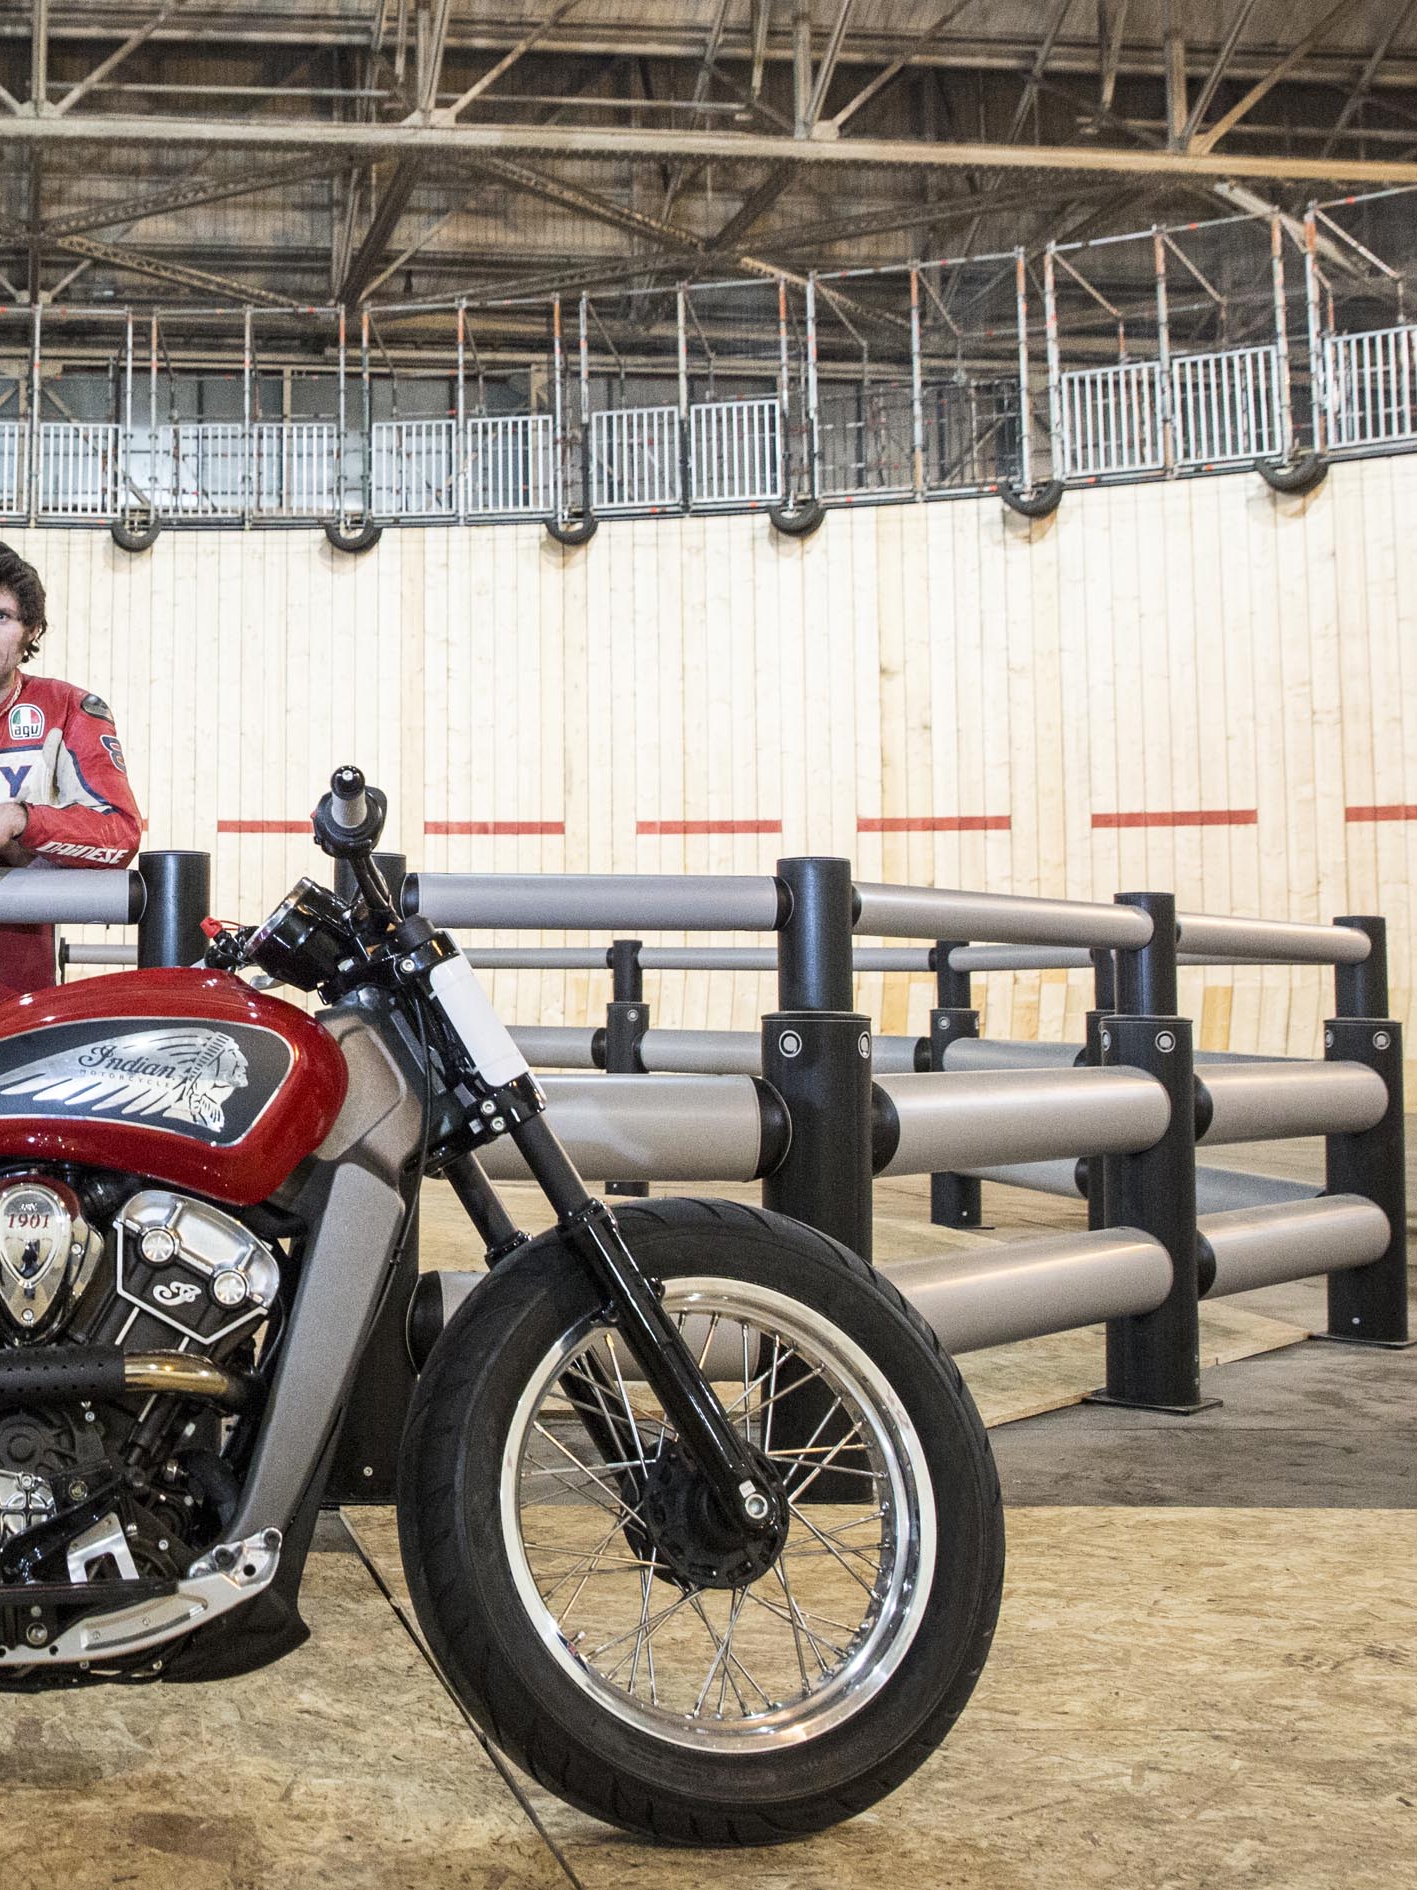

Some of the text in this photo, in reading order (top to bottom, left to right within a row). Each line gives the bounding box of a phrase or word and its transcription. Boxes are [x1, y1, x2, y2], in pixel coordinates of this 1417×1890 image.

[14, 724, 39, 738] agv
[78, 1044, 177, 1079] Indian
[79, 1068, 170, 1088] MOTORCYCLE
[7, 1213, 50, 1229] 1901
